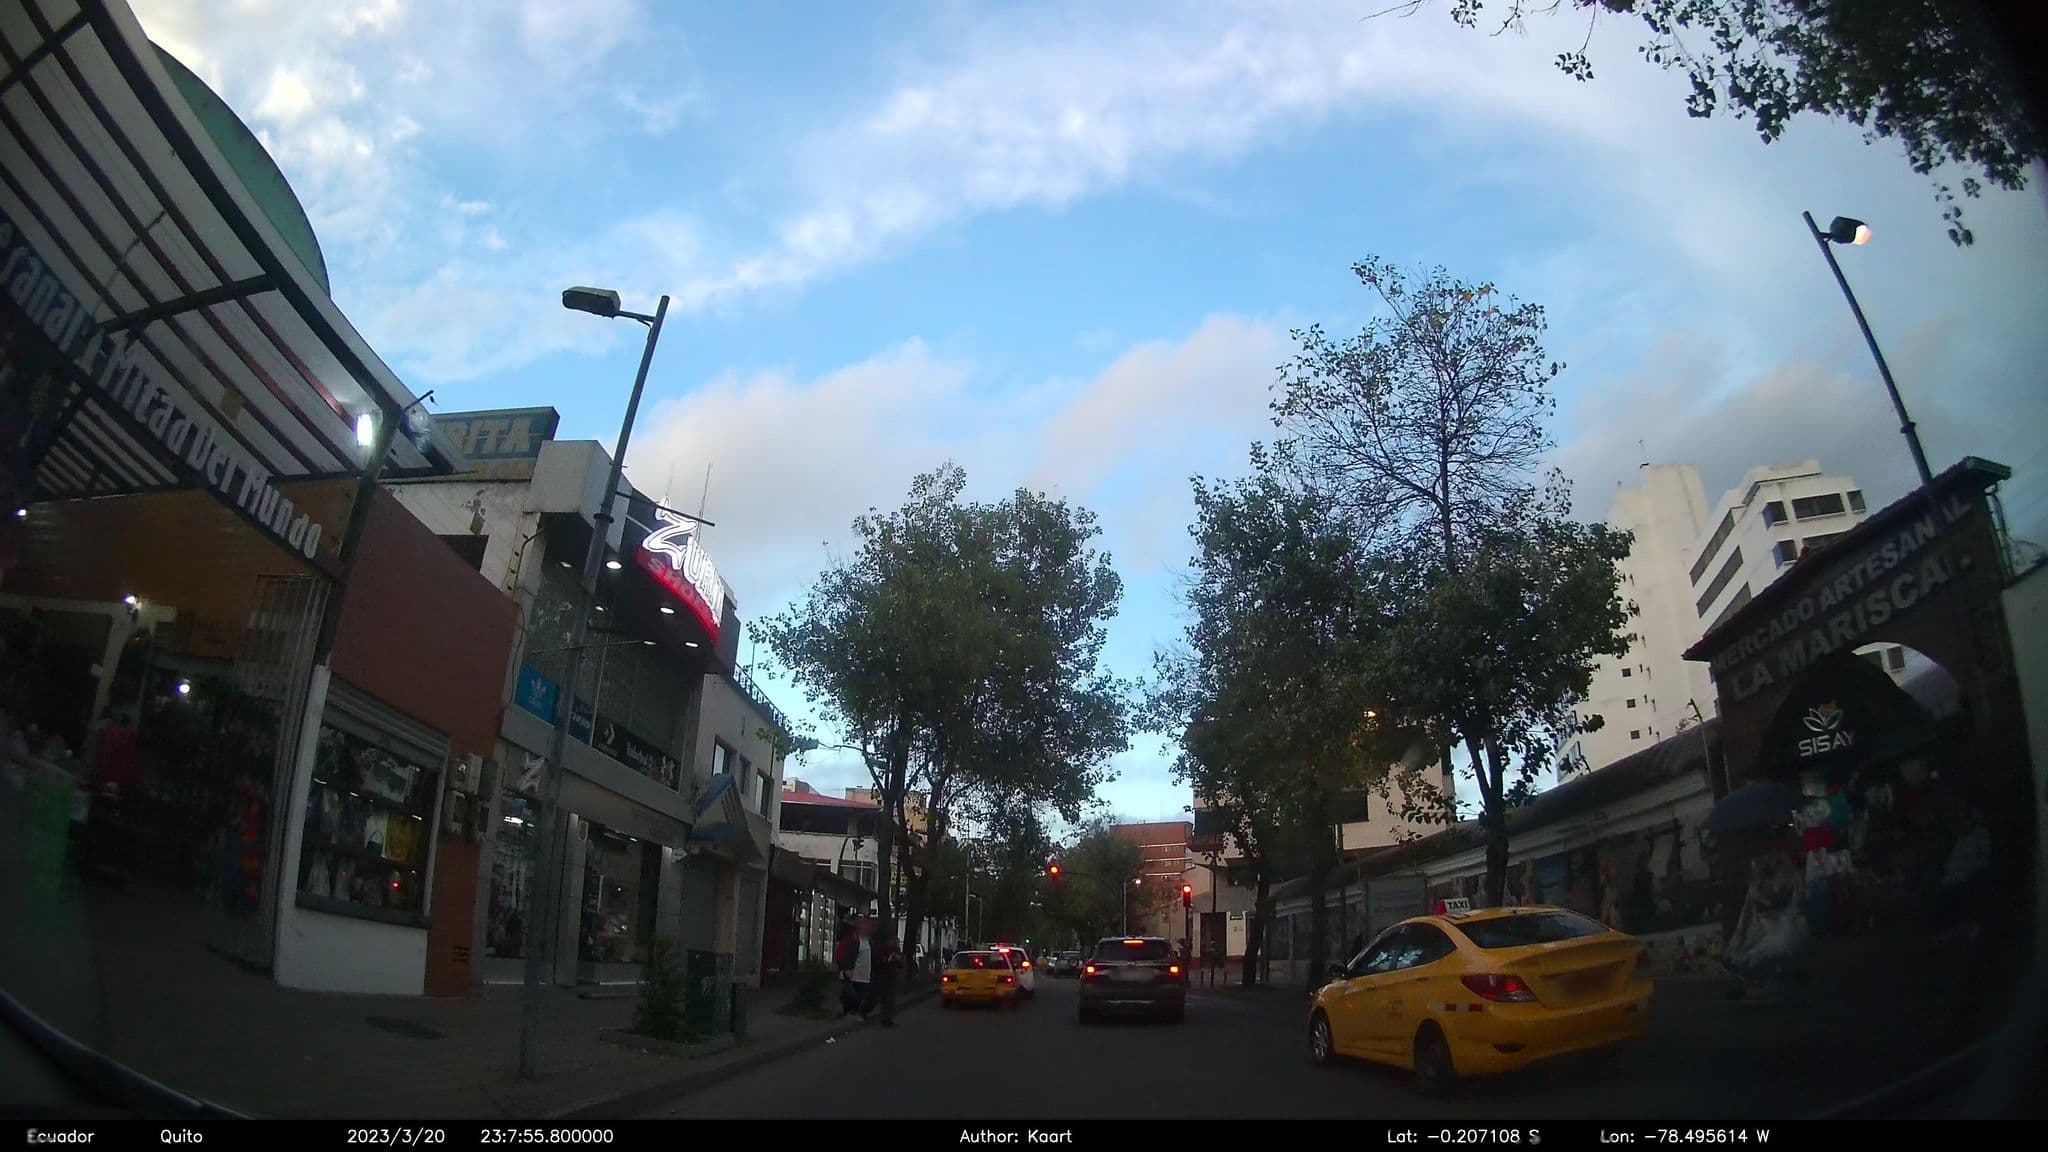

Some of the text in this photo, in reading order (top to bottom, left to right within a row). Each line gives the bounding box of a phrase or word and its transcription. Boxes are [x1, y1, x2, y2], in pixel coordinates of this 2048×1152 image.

[236, 470, 323, 560] Mundo
[1731, 661, 1776, 702] LA
[1798, 729, 1854, 758] SISAY
[1447, 900, 1469, 910] TAXI
